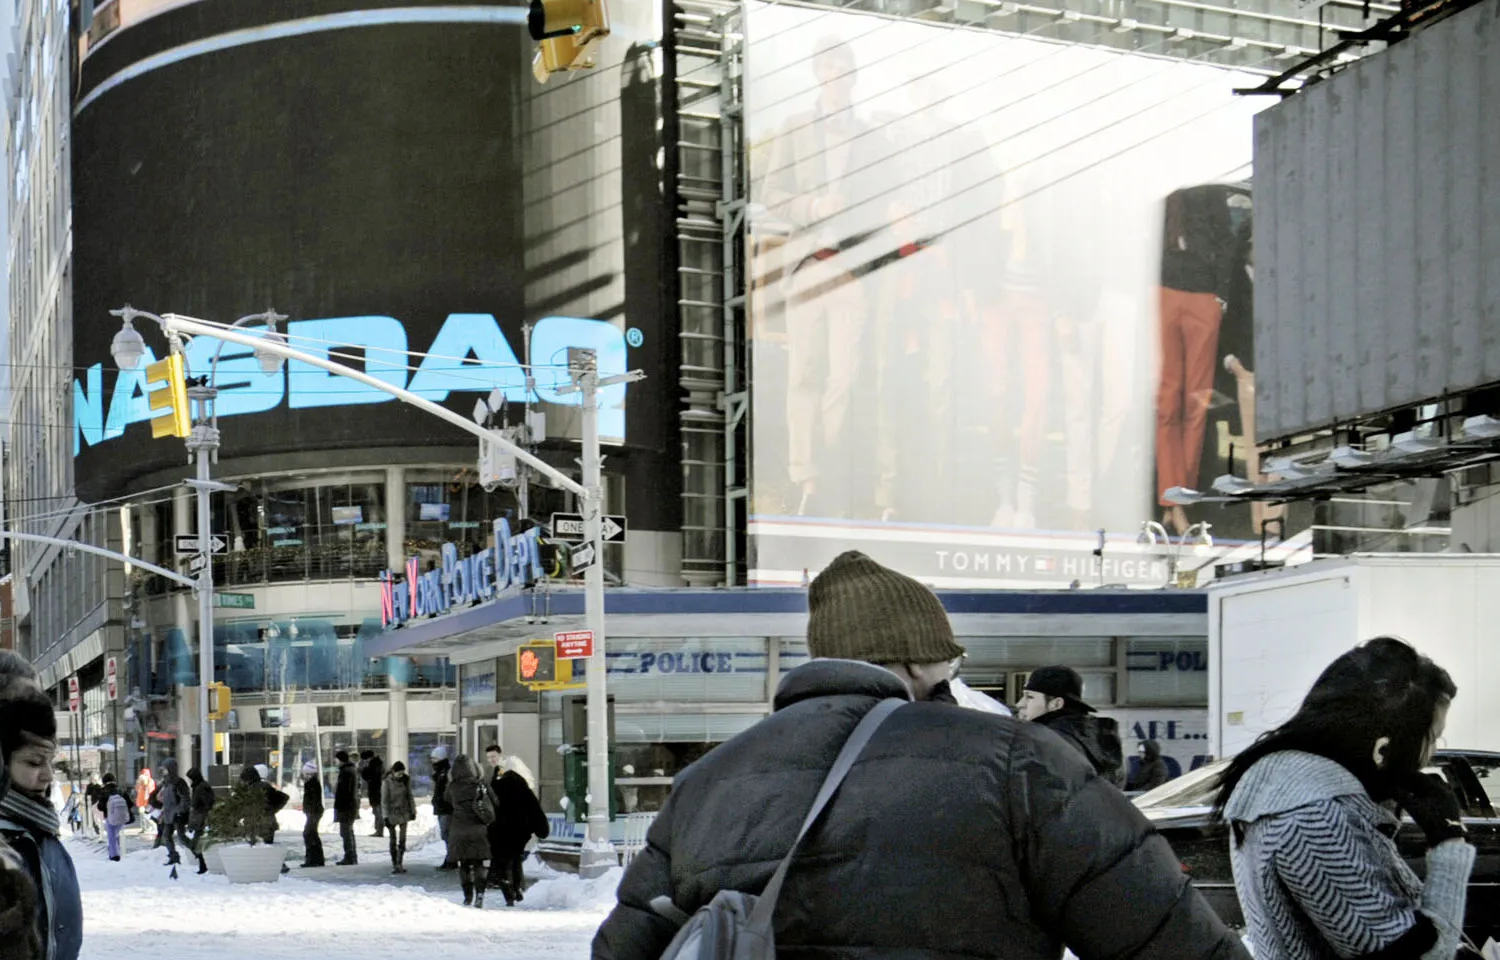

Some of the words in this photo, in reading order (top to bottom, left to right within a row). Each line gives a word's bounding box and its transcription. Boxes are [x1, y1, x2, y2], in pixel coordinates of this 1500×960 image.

[73, 312, 627, 456] NASDAQ
[563, 522, 584, 533] ONE
[936, 551, 1030, 573] TOMMY
[1063, 557, 1162, 580] HILFIGER
[380, 569, 408, 629] NEW
[406, 556, 445, 618] YORK
[441, 542, 494, 609] POLICE
[640, 652, 733, 673] POLICE
